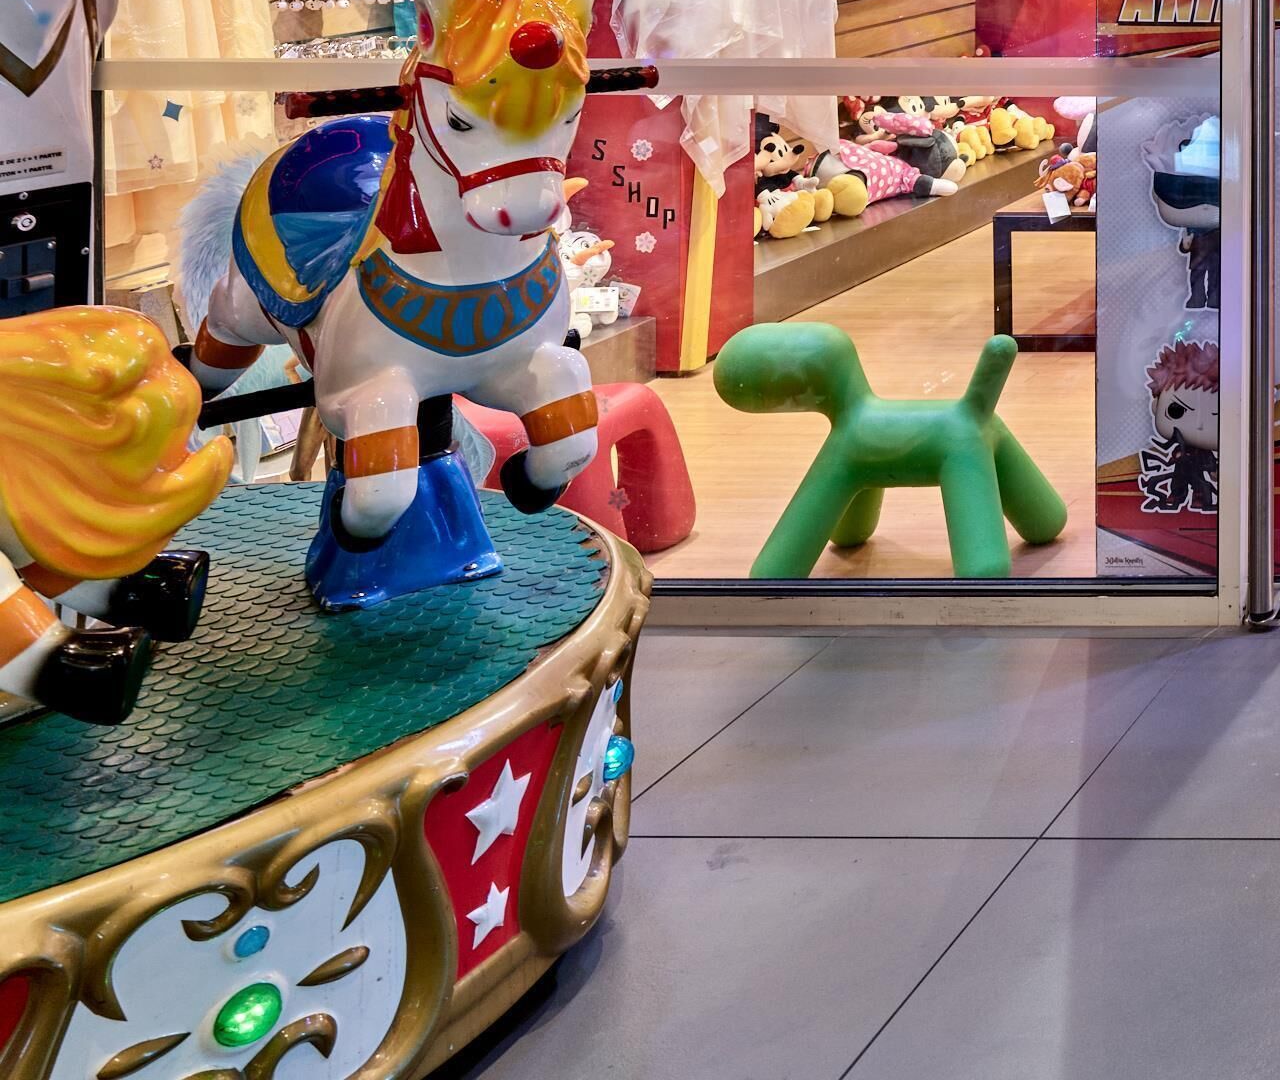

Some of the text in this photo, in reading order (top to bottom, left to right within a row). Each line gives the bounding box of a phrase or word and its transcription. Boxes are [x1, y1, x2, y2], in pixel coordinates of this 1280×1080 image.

[39, 151, 62, 160] PARTIE
[591, 139, 607, 161] S
[612, 165, 675, 230] SHOP
